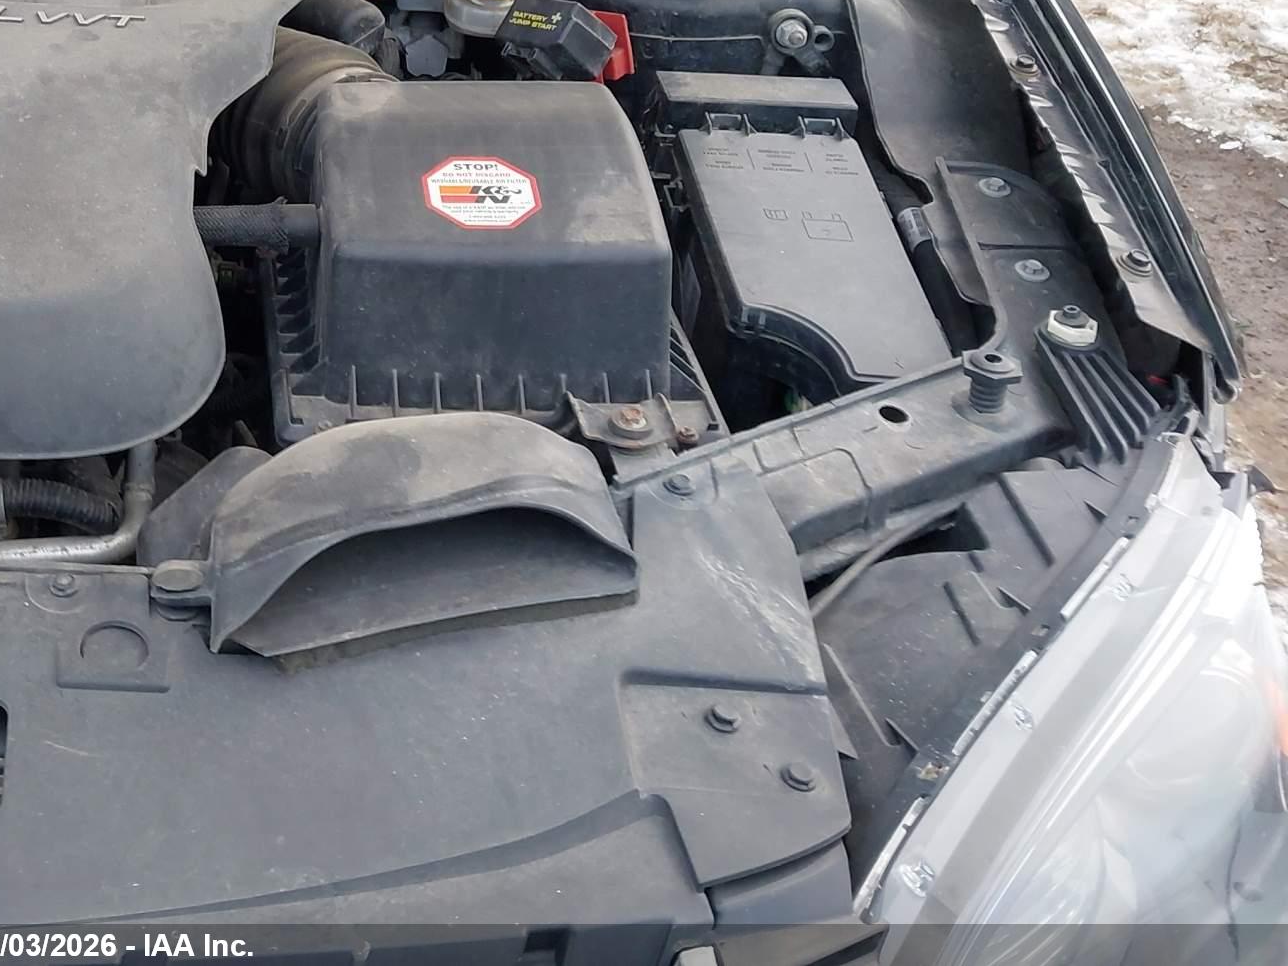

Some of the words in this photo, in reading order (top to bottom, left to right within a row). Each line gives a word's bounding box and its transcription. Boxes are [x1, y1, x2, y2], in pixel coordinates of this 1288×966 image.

[37, 10, 146, 27] VVT
[513, 10, 548, 22] BATTERY
[509, 18, 531, 26] JUMP
[532, 22, 557, 31] START
